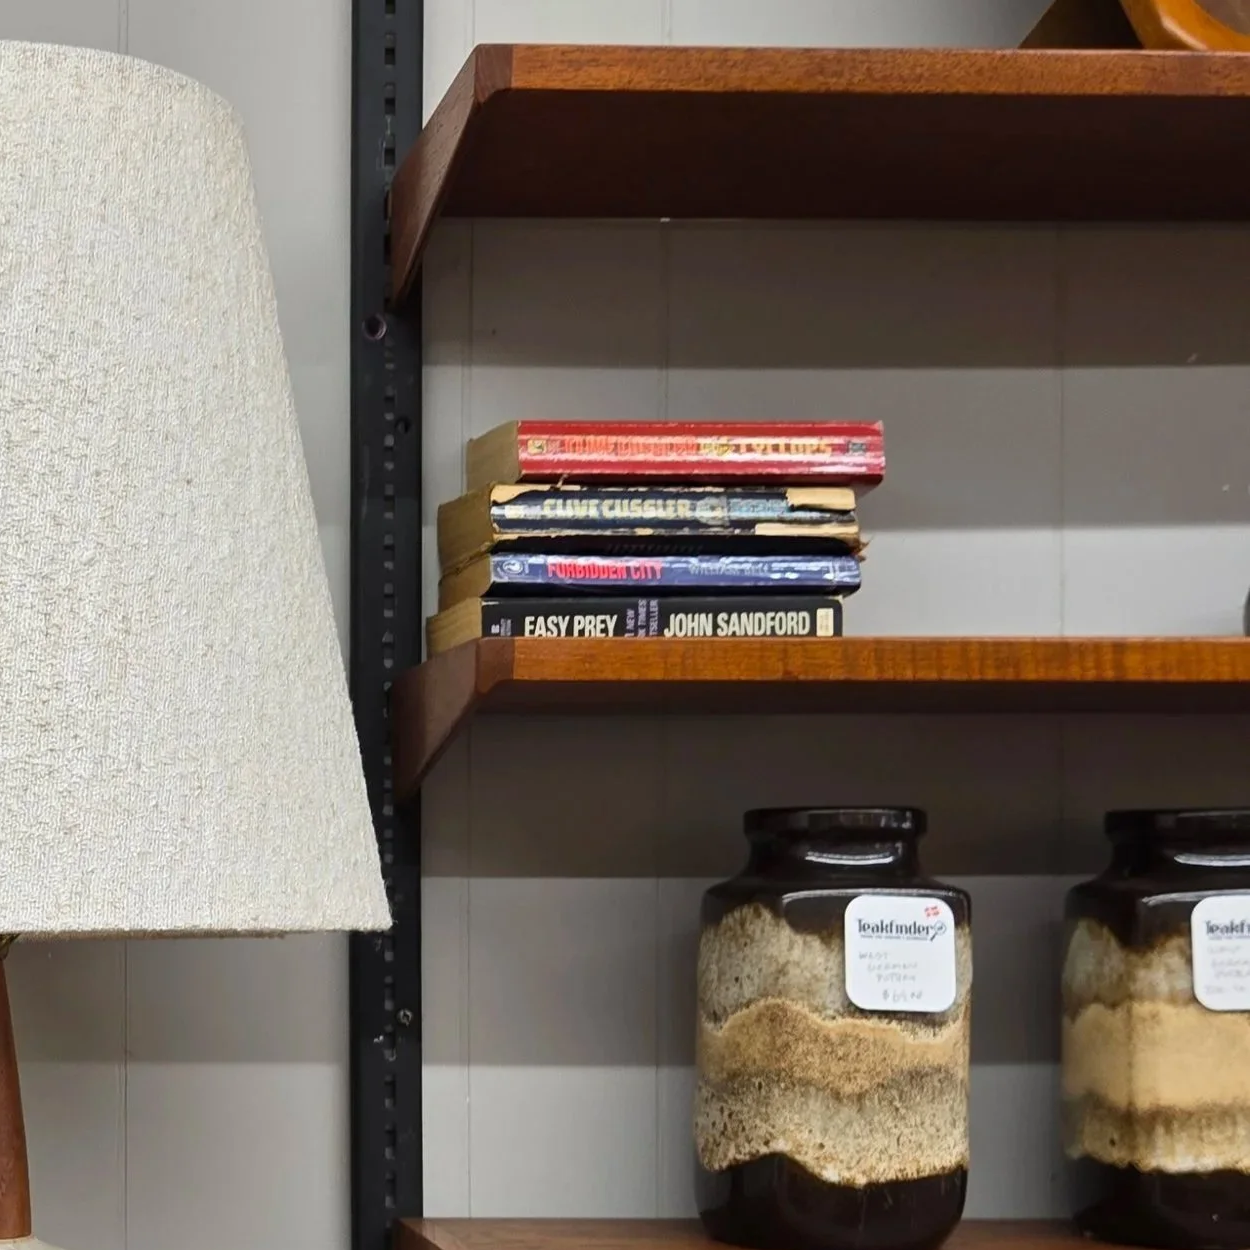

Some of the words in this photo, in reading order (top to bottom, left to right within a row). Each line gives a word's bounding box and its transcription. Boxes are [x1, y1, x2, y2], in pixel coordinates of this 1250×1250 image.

[542, 499, 599, 519] CLIVE
[601, 499, 691, 519] CUSSLER
[547, 561, 627, 579] FORBIDDEN
[630, 561, 664, 580] CITY
[523, 615, 571, 637] EASY
[572, 614, 619, 637] PREY
[663, 612, 713, 637] JOHN
[716, 610, 811, 637] SANDFORD
[856, 918, 934, 935] Teakfinder
